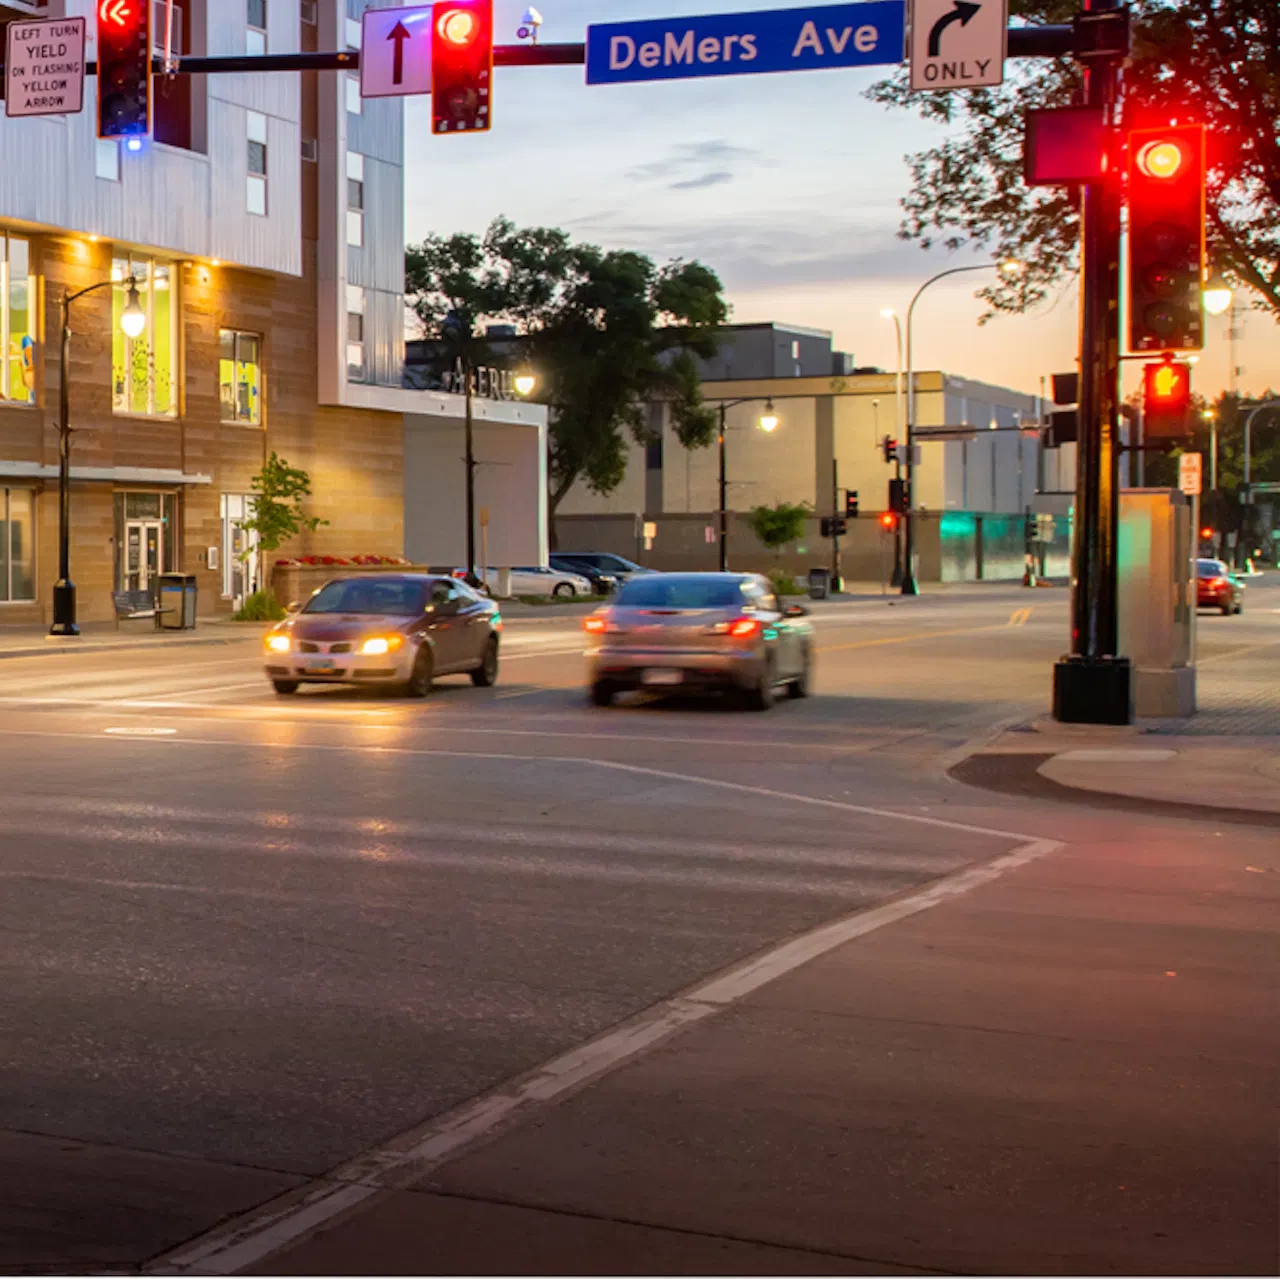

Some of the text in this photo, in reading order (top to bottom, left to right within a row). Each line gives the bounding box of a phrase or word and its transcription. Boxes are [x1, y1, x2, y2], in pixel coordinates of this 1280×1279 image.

[14, 24, 80, 41] LEFT TURN
[26, 43, 67, 59] YIELD
[608, 20, 879, 71] DeMers Ave
[12, 61, 80, 78] ON FLASHING
[924, 58, 992, 82] ONLY
[22, 80, 68, 93] YELLOW
[24, 96, 65, 109] ARROW
